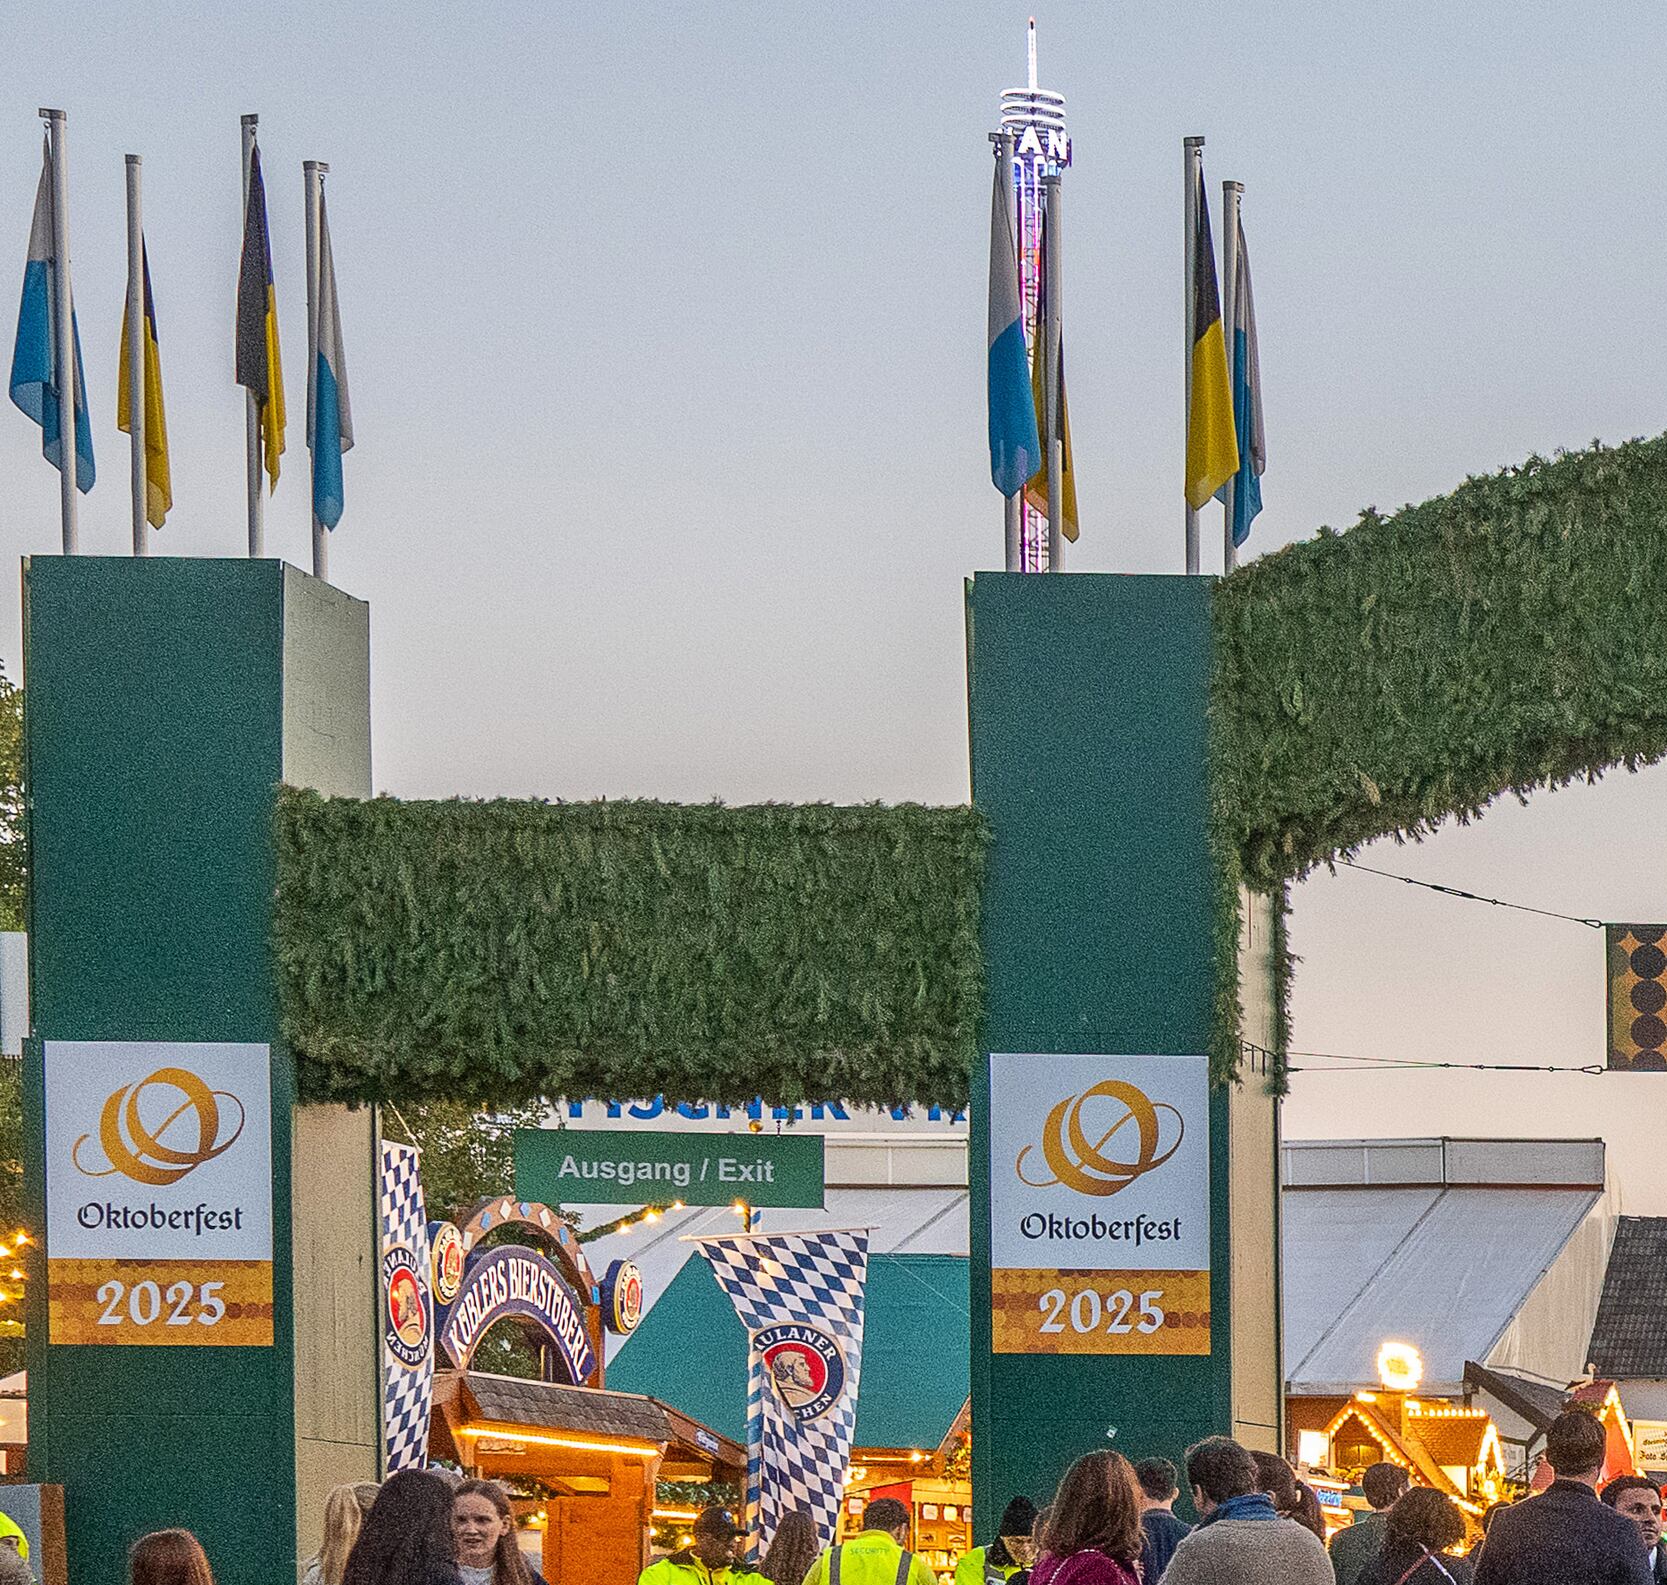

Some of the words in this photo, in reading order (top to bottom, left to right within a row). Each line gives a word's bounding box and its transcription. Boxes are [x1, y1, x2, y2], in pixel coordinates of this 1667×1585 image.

[557, 1155, 691, 1188] Ausgang
[699, 1158, 708, 1183] /
[718, 1158, 775, 1184] Exit
[77, 1202, 244, 1236] Oktoberfest
[1020, 1212, 1182, 1247] Oktoberfest
[96, 1280, 227, 1326] 2025
[1039, 1288, 1165, 1334] 2025
